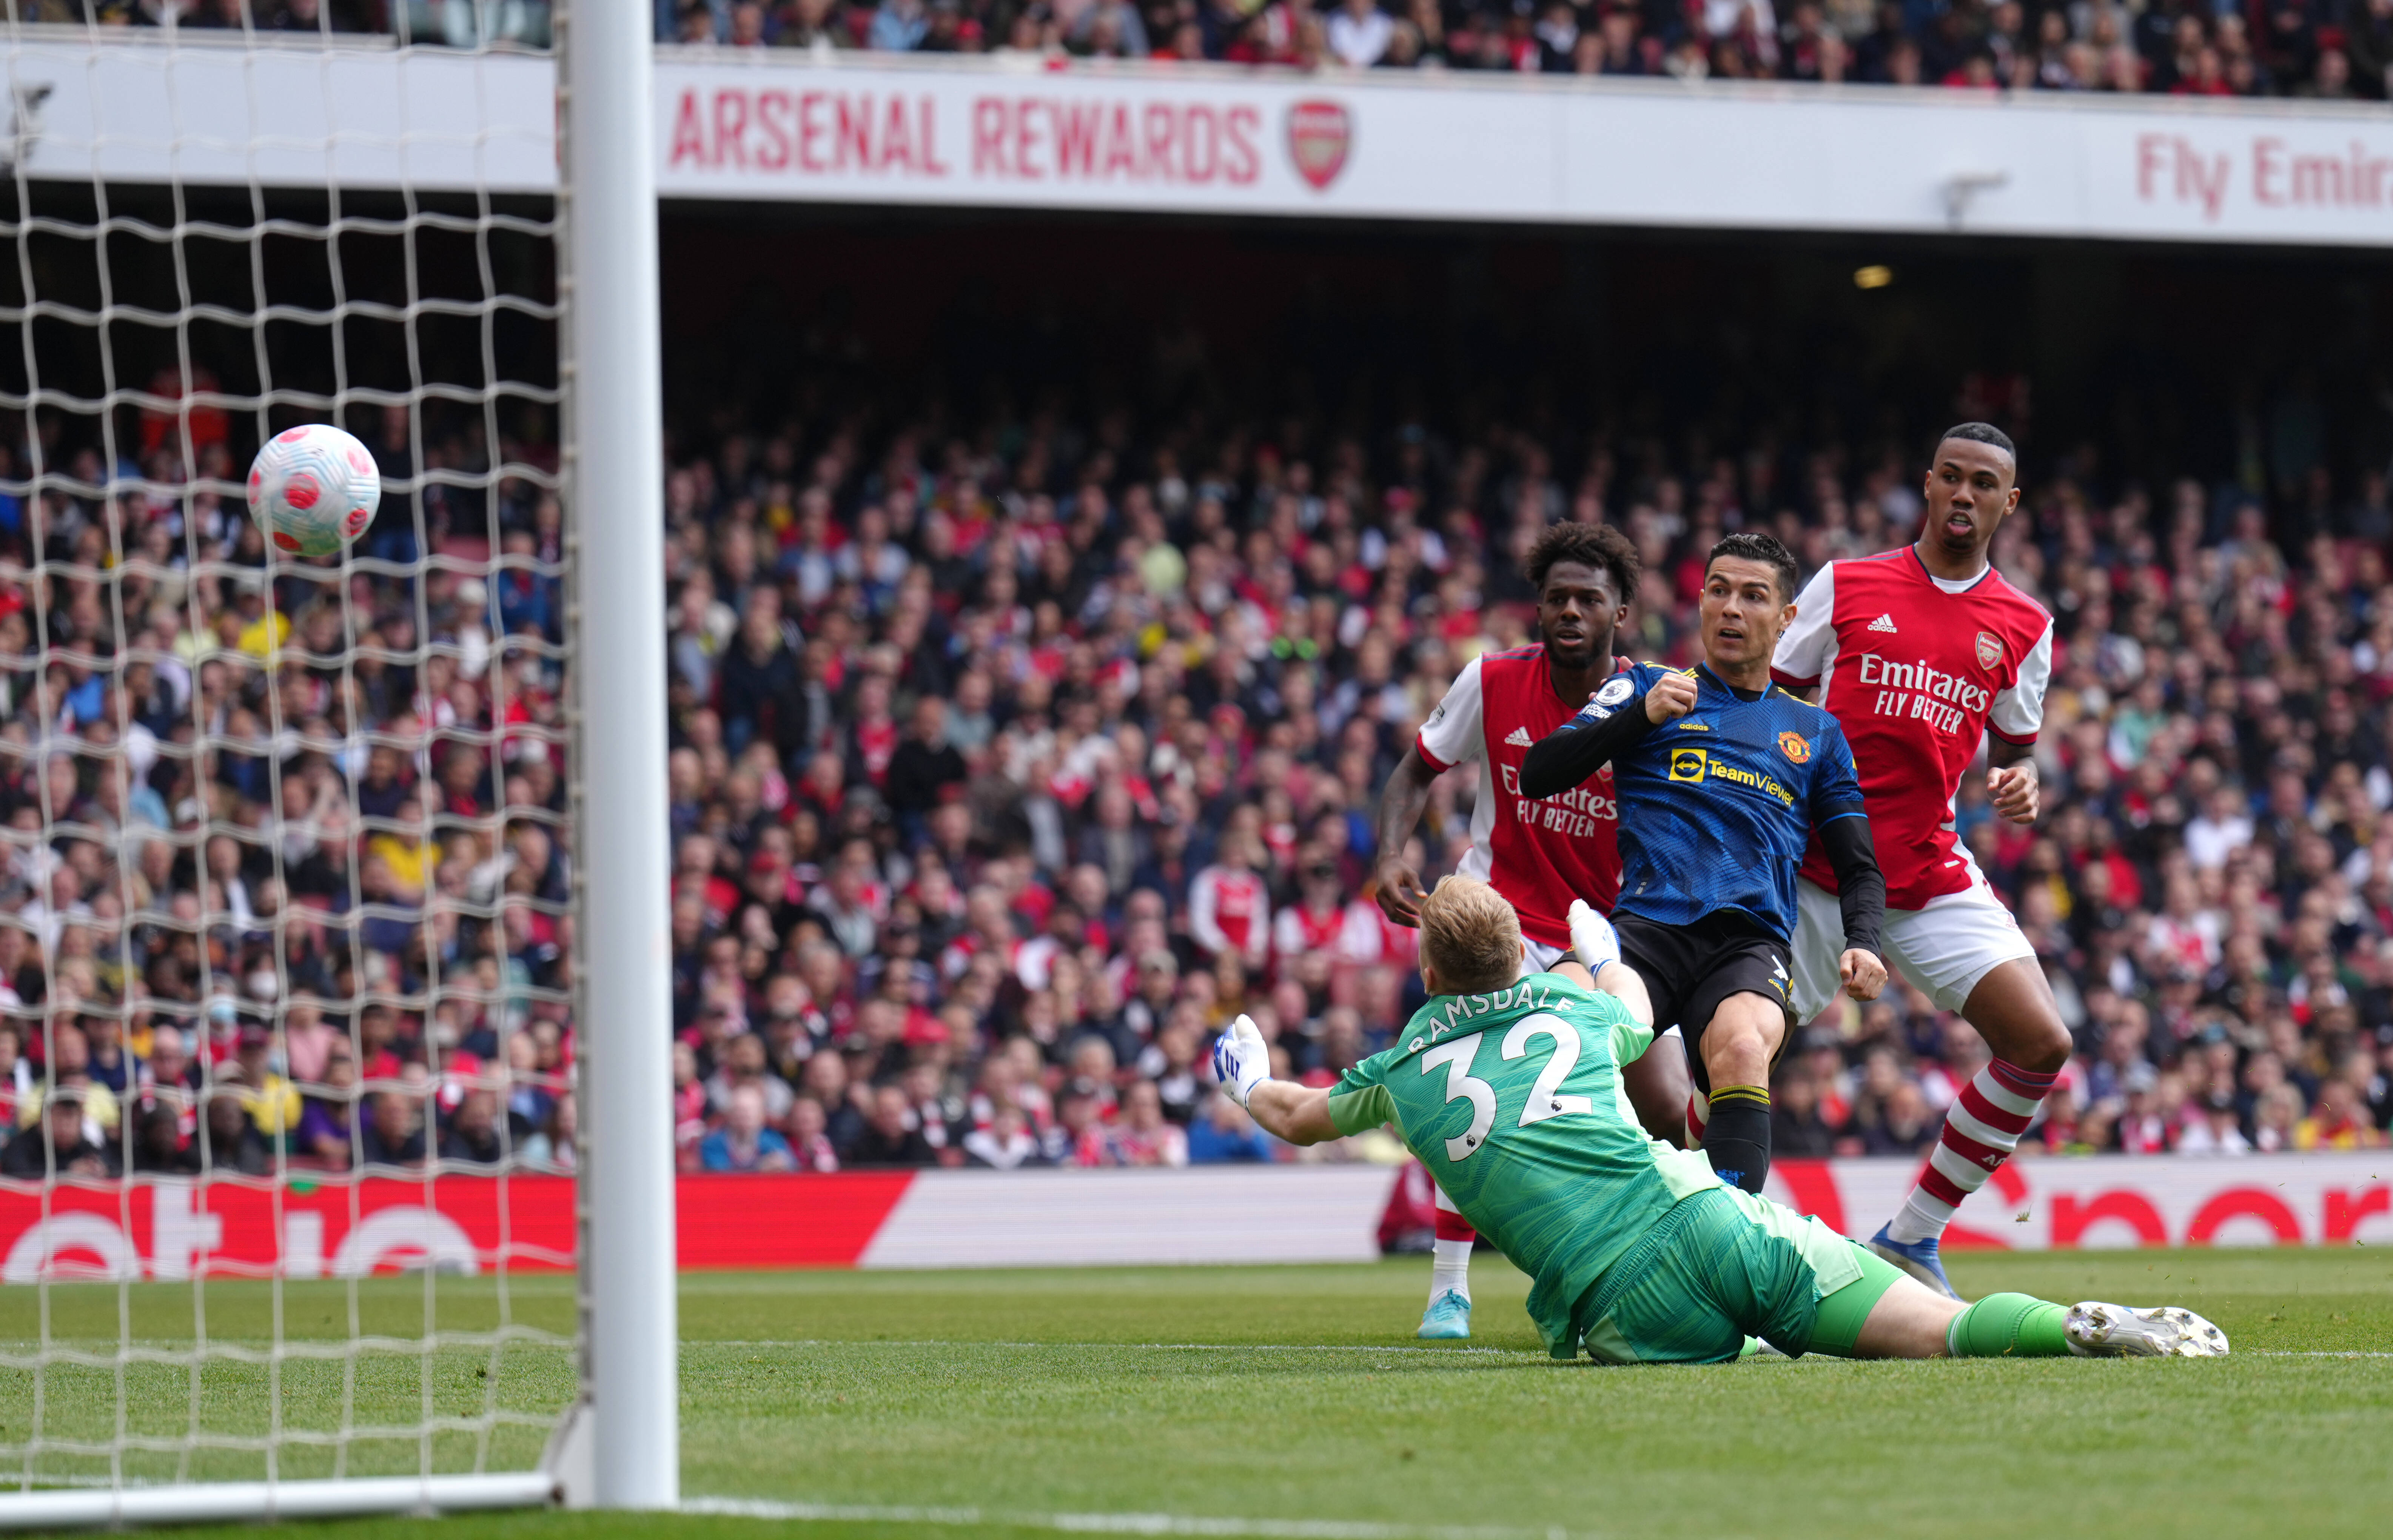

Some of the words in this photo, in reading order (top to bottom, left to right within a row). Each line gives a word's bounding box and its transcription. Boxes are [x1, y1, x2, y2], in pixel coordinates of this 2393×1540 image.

[670, 88, 948, 176] ARSENAL
[972, 97, 1262, 185] REWARDS
[2137, 132, 2231, 223] Fly
[2252, 136, 2393, 208] Emir
[1867, 624, 1898, 633] adidas
[1980, 636, 1999, 650] Arsenal
[1860, 653, 1989, 713] Emirates
[1874, 690, 1909, 716] FLY
[1910, 695, 1965, 735] BETTER
[1504, 737, 1534, 747] adidas
[1500, 763, 1618, 821] Eates
[1708, 759, 1794, 807] TeamViewer
[1517, 800, 1541, 824] FLY
[1543, 807, 1595, 838] BETTER
[1407, 983, 1575, 1054] RAMSDALE
[1421, 1012, 1593, 1163] 32
